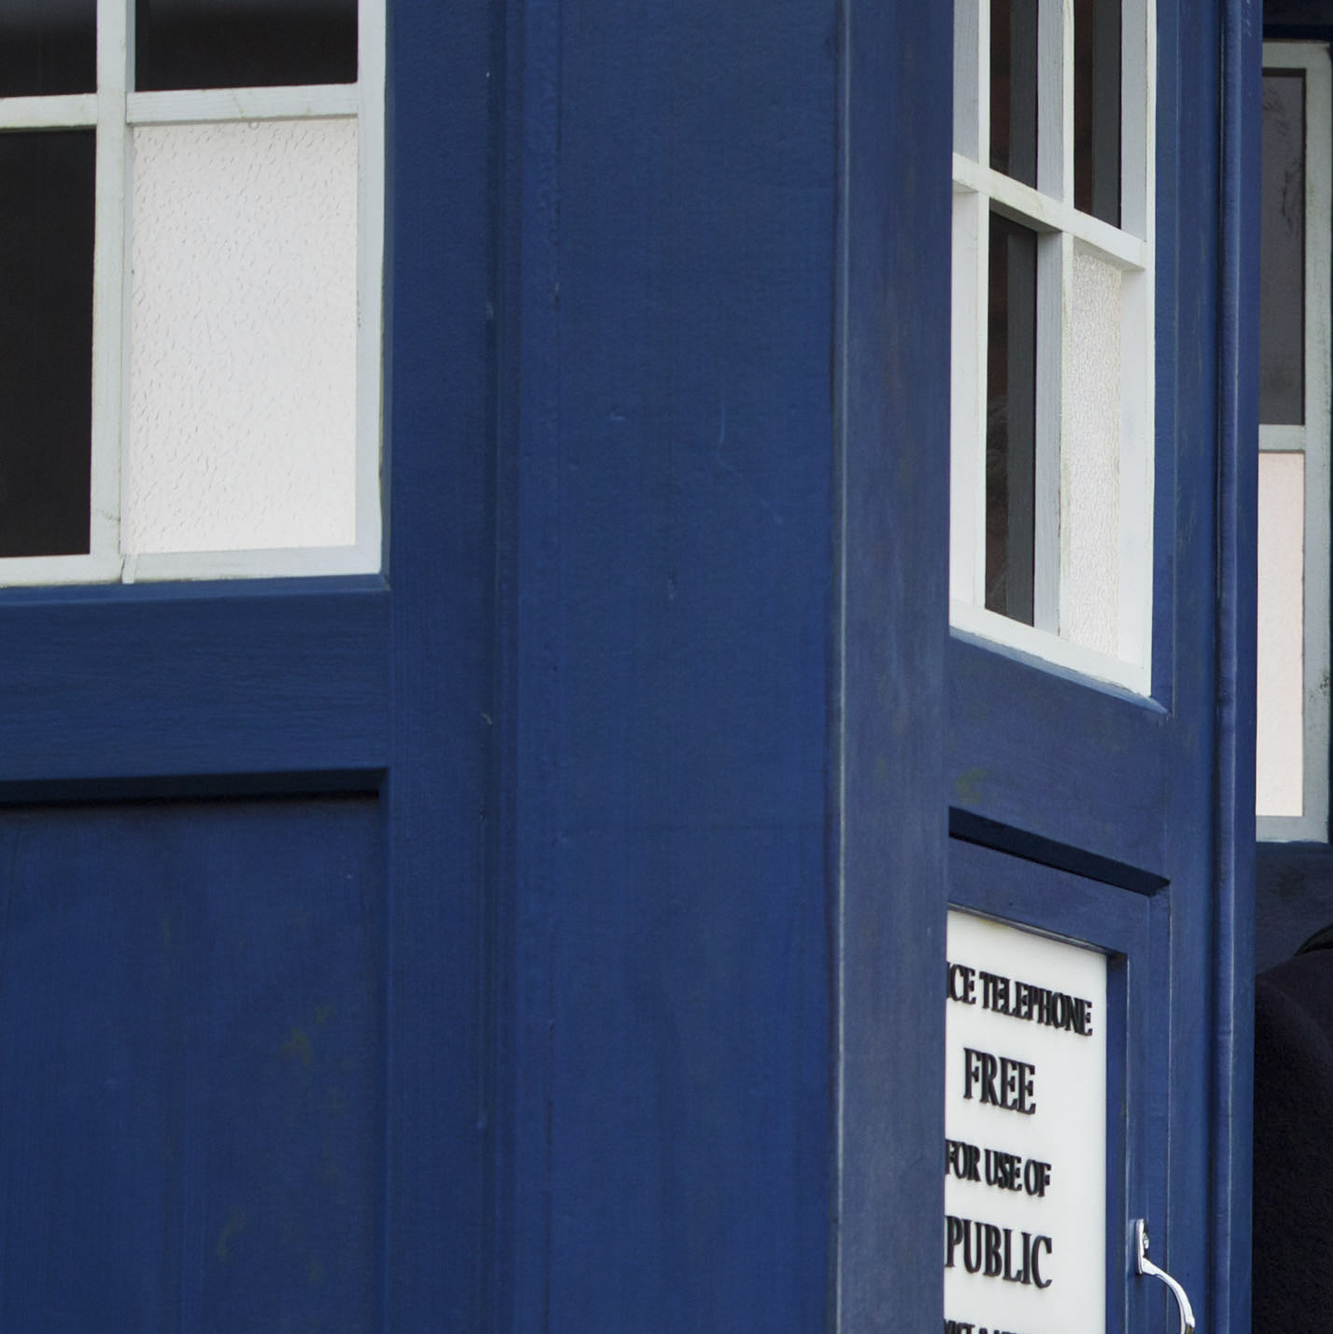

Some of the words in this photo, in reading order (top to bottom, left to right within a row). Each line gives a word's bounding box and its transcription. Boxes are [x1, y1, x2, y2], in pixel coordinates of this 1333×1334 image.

[979, 971, 1093, 1036] TELEPHONE
[963, 1047, 1036, 1115] FREE
[945, 1139, 981, 1182] FOR
[984, 1149, 1022, 1191] USE
[1024, 1159, 1051, 1198] OF
[945, 1215, 1052, 1289] PUBLIC
